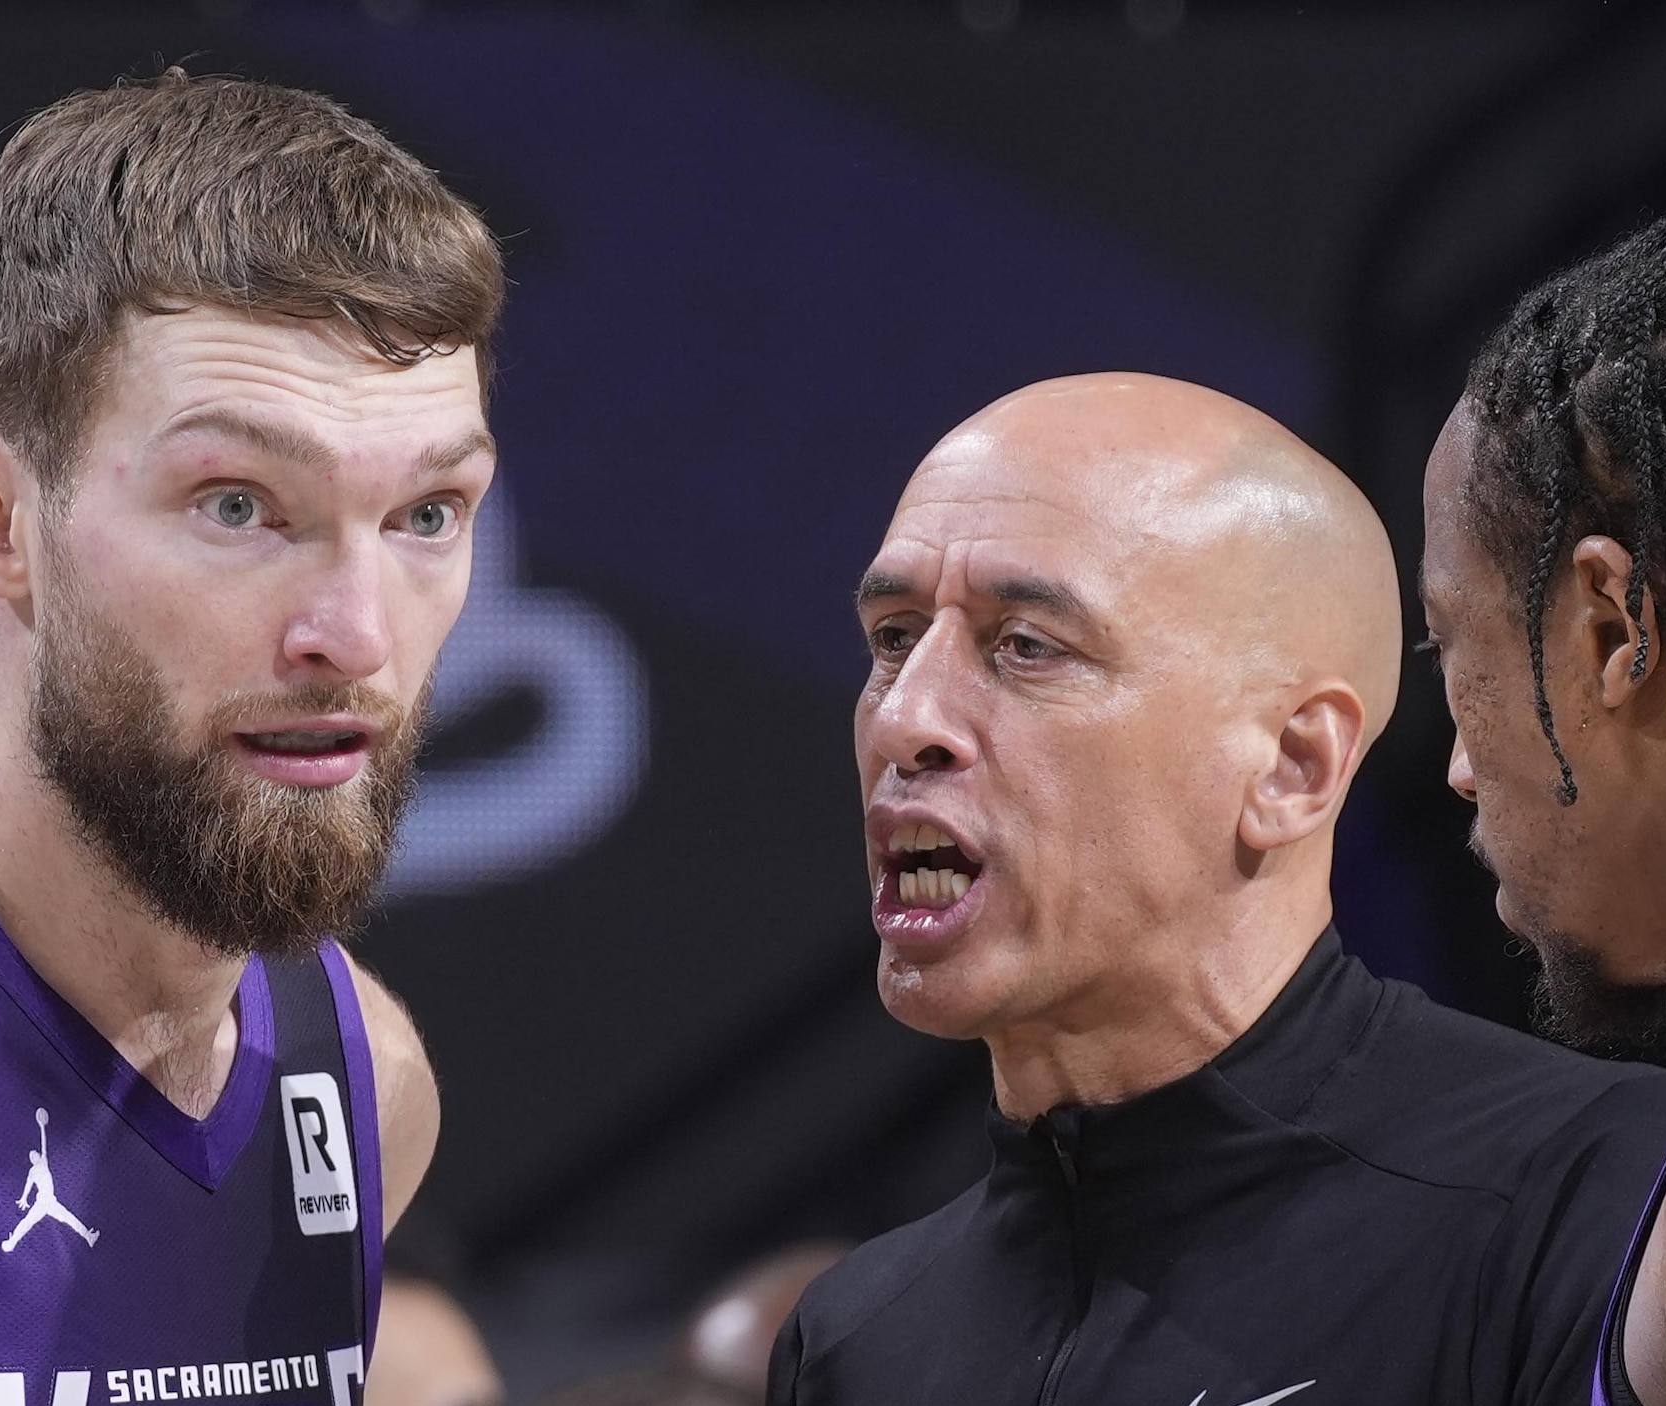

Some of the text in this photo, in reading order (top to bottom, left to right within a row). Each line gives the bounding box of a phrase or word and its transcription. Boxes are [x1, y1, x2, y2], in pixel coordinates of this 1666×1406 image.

[291, 1097, 336, 1173] R
[299, 1193, 350, 1215] REVIVER
[107, 1354, 320, 1403] SACRAMENTO
